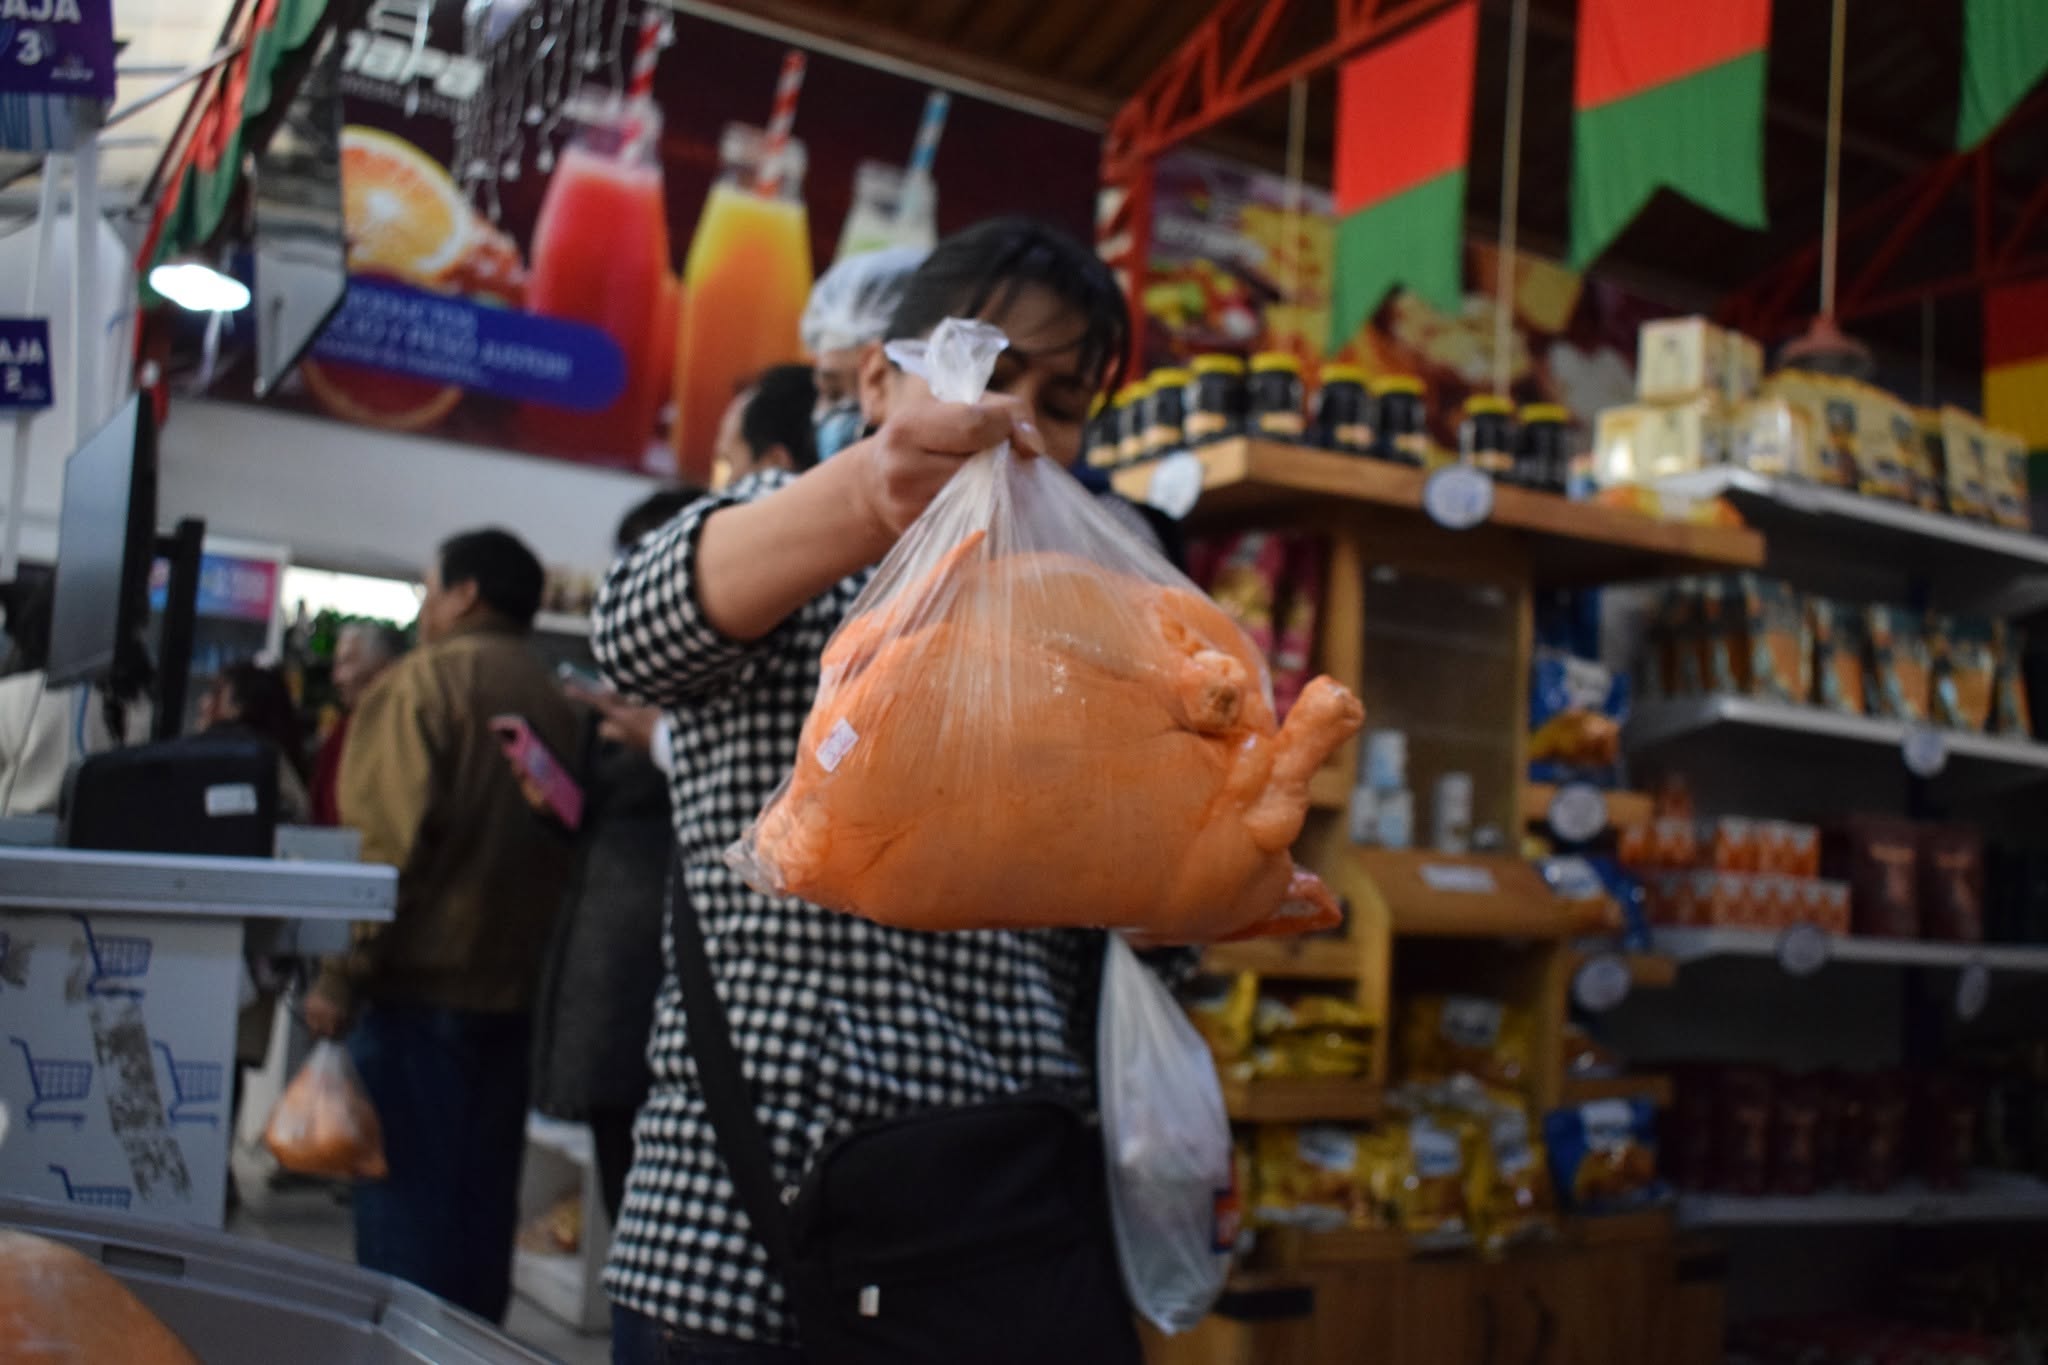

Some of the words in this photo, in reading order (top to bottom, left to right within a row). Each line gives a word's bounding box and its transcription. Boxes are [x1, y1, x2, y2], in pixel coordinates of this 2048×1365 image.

[0, 0, 81, 23] AJA
[16, 28, 42, 65] 3
[5, 366, 23, 393] 2
